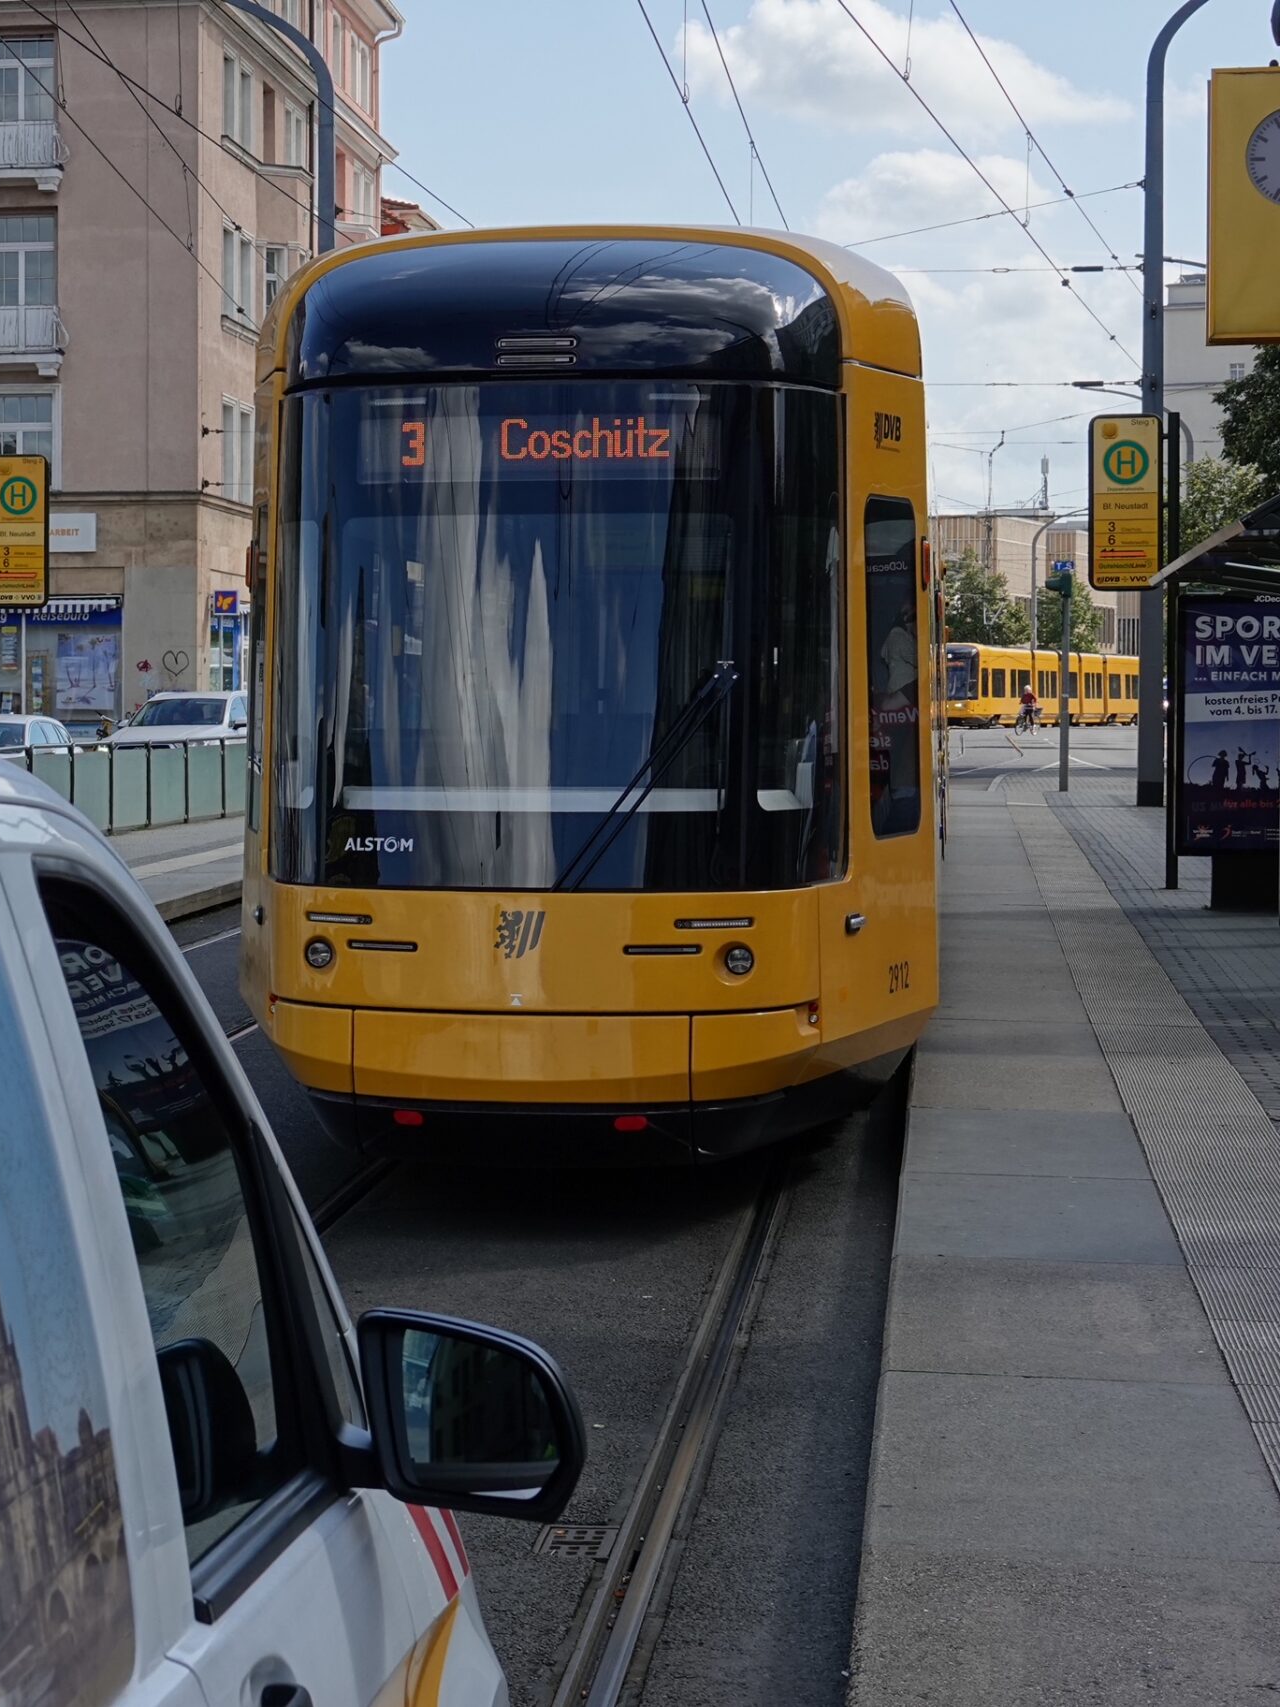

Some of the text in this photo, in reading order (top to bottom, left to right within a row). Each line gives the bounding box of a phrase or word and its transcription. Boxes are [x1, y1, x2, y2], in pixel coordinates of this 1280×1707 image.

[401, 416, 671, 467] 3 Coschütz
[1114, 502, 1149, 510] Neustadt
[1108, 521, 1116, 532] 3
[1108, 534, 1116, 545] 6
[3, 546, 10, 556] 3
[3, 558, 10, 568] 6
[1195, 645, 1232, 667] IM
[1211, 671, 1267, 681] EINFACH
[1204, 694, 1269, 706] kostenfreies
[1209, 707, 1232, 716] vom
[1247, 705, 1262, 715] bis
[343, 836, 414, 853] ALSTOM
[888, 960, 910, 994] 2912
